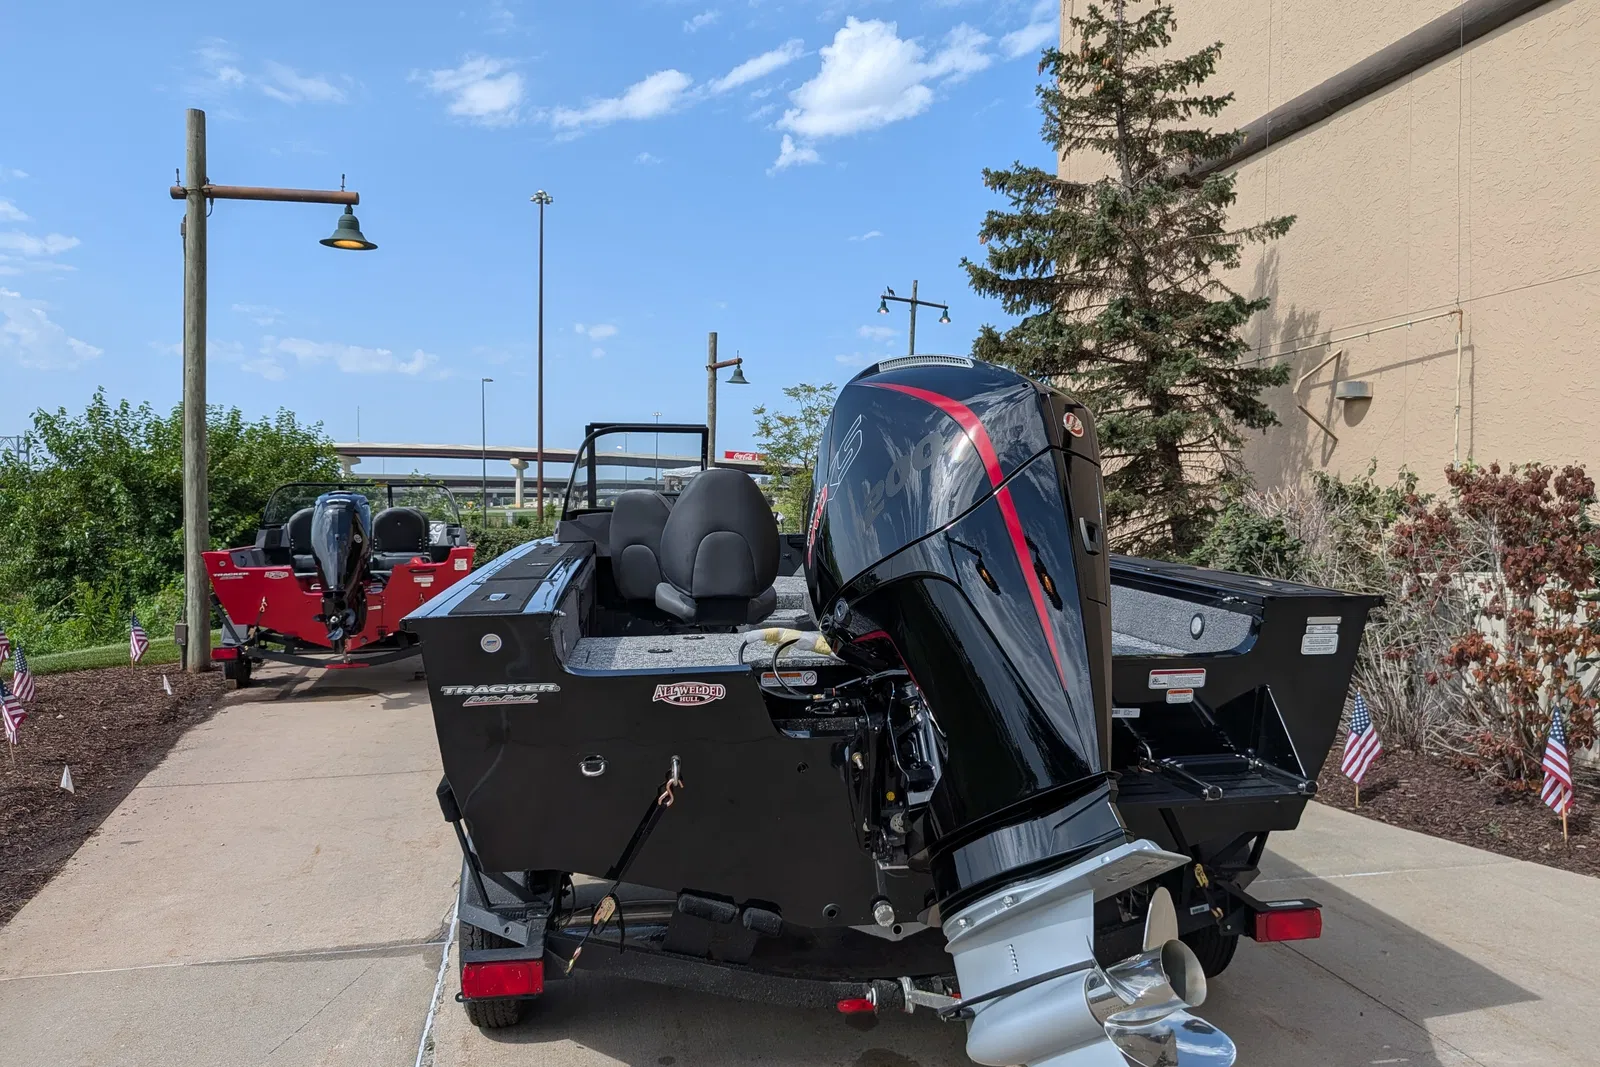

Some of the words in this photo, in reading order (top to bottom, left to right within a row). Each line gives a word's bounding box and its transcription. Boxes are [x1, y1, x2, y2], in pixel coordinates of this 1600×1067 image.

[442, 683, 556, 695] TRACKER
[655, 686, 677, 699] ALL
[678, 686, 724, 697] WELDED
